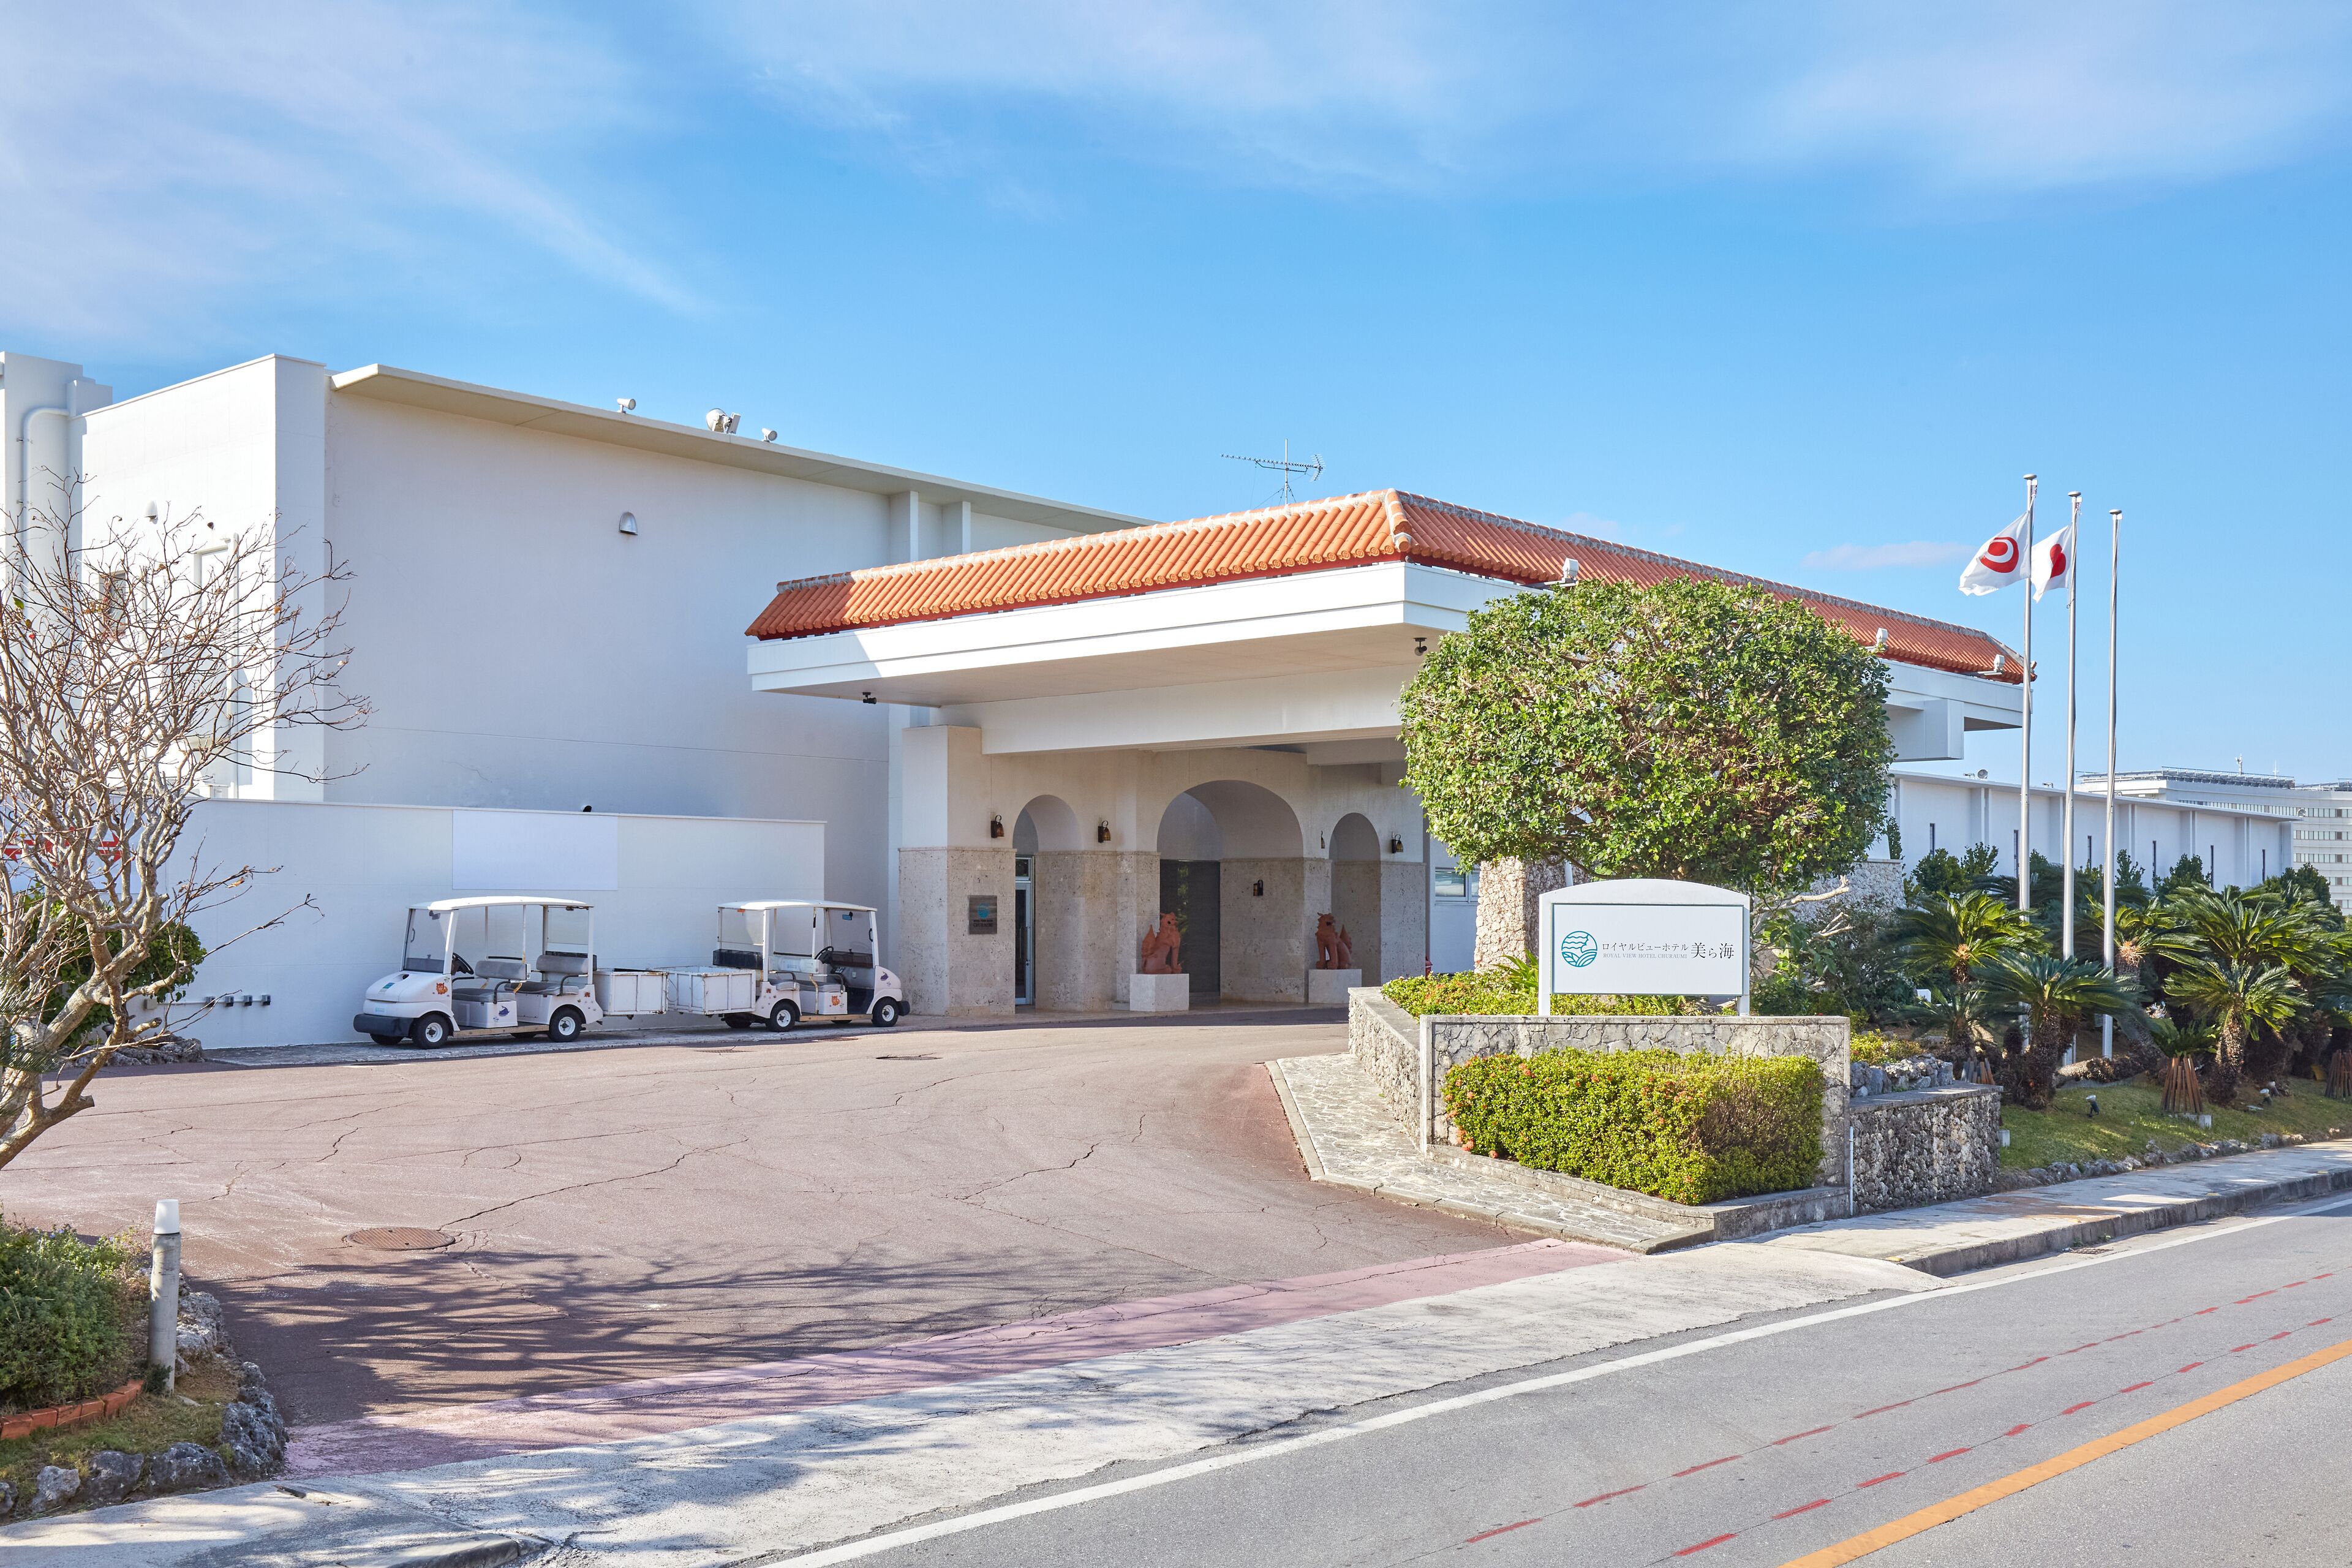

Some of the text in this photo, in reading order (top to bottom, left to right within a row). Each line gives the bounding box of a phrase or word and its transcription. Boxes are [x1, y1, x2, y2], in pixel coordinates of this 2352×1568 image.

[1602, 942, 1735, 959] ロイヤルビューホテル 美ら海
